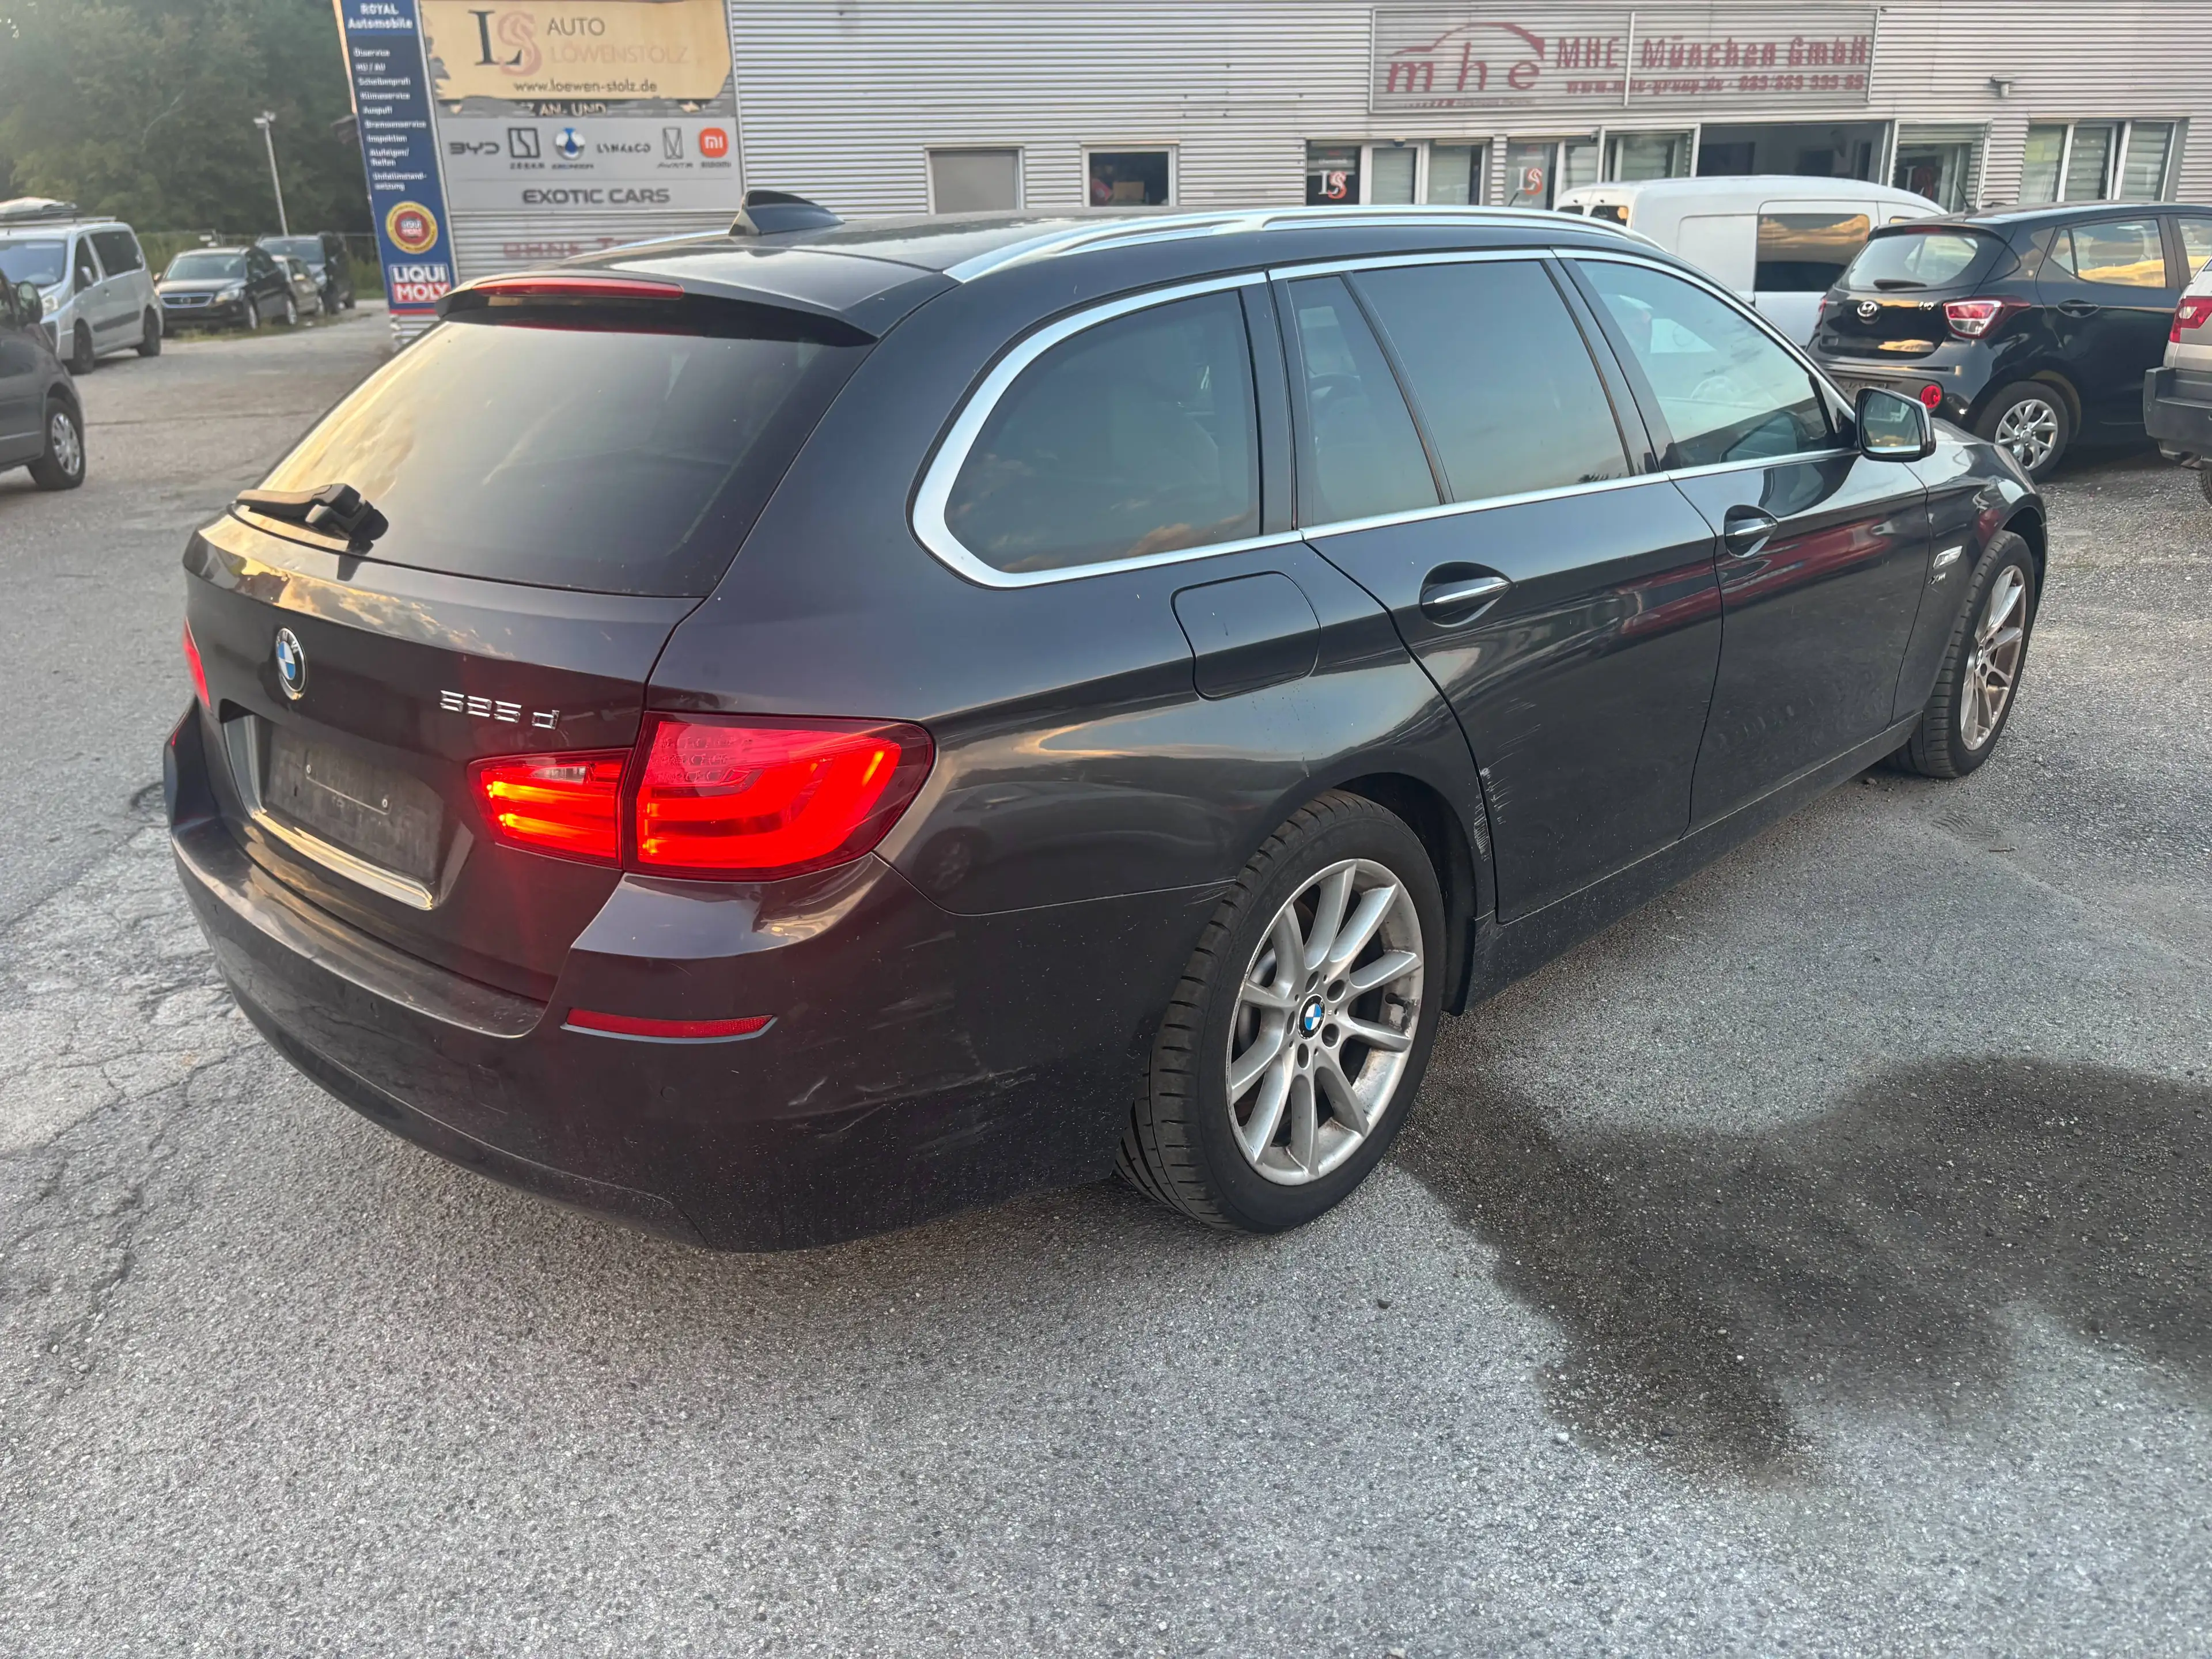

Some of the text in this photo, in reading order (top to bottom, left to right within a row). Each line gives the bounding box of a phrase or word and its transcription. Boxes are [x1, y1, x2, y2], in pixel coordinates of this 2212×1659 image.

[360, 3, 399, 15] ROYAL
[348, 17, 413, 29] Automobile
[547, 17, 605, 36] AUTO
[550, 41, 690, 65] LÖWENSTOLZ
[1556, 34, 1867, 69] MHE München GmbH
[513, 78, 657, 93] www.loewen-stolz.de
[448, 141, 501, 155] BYD
[522, 188, 671, 204] EXOTIC CARS
[392, 266, 447, 283] LIQUI
[396, 284, 450, 301] MOLY
[439, 690, 560, 730] 525 d
